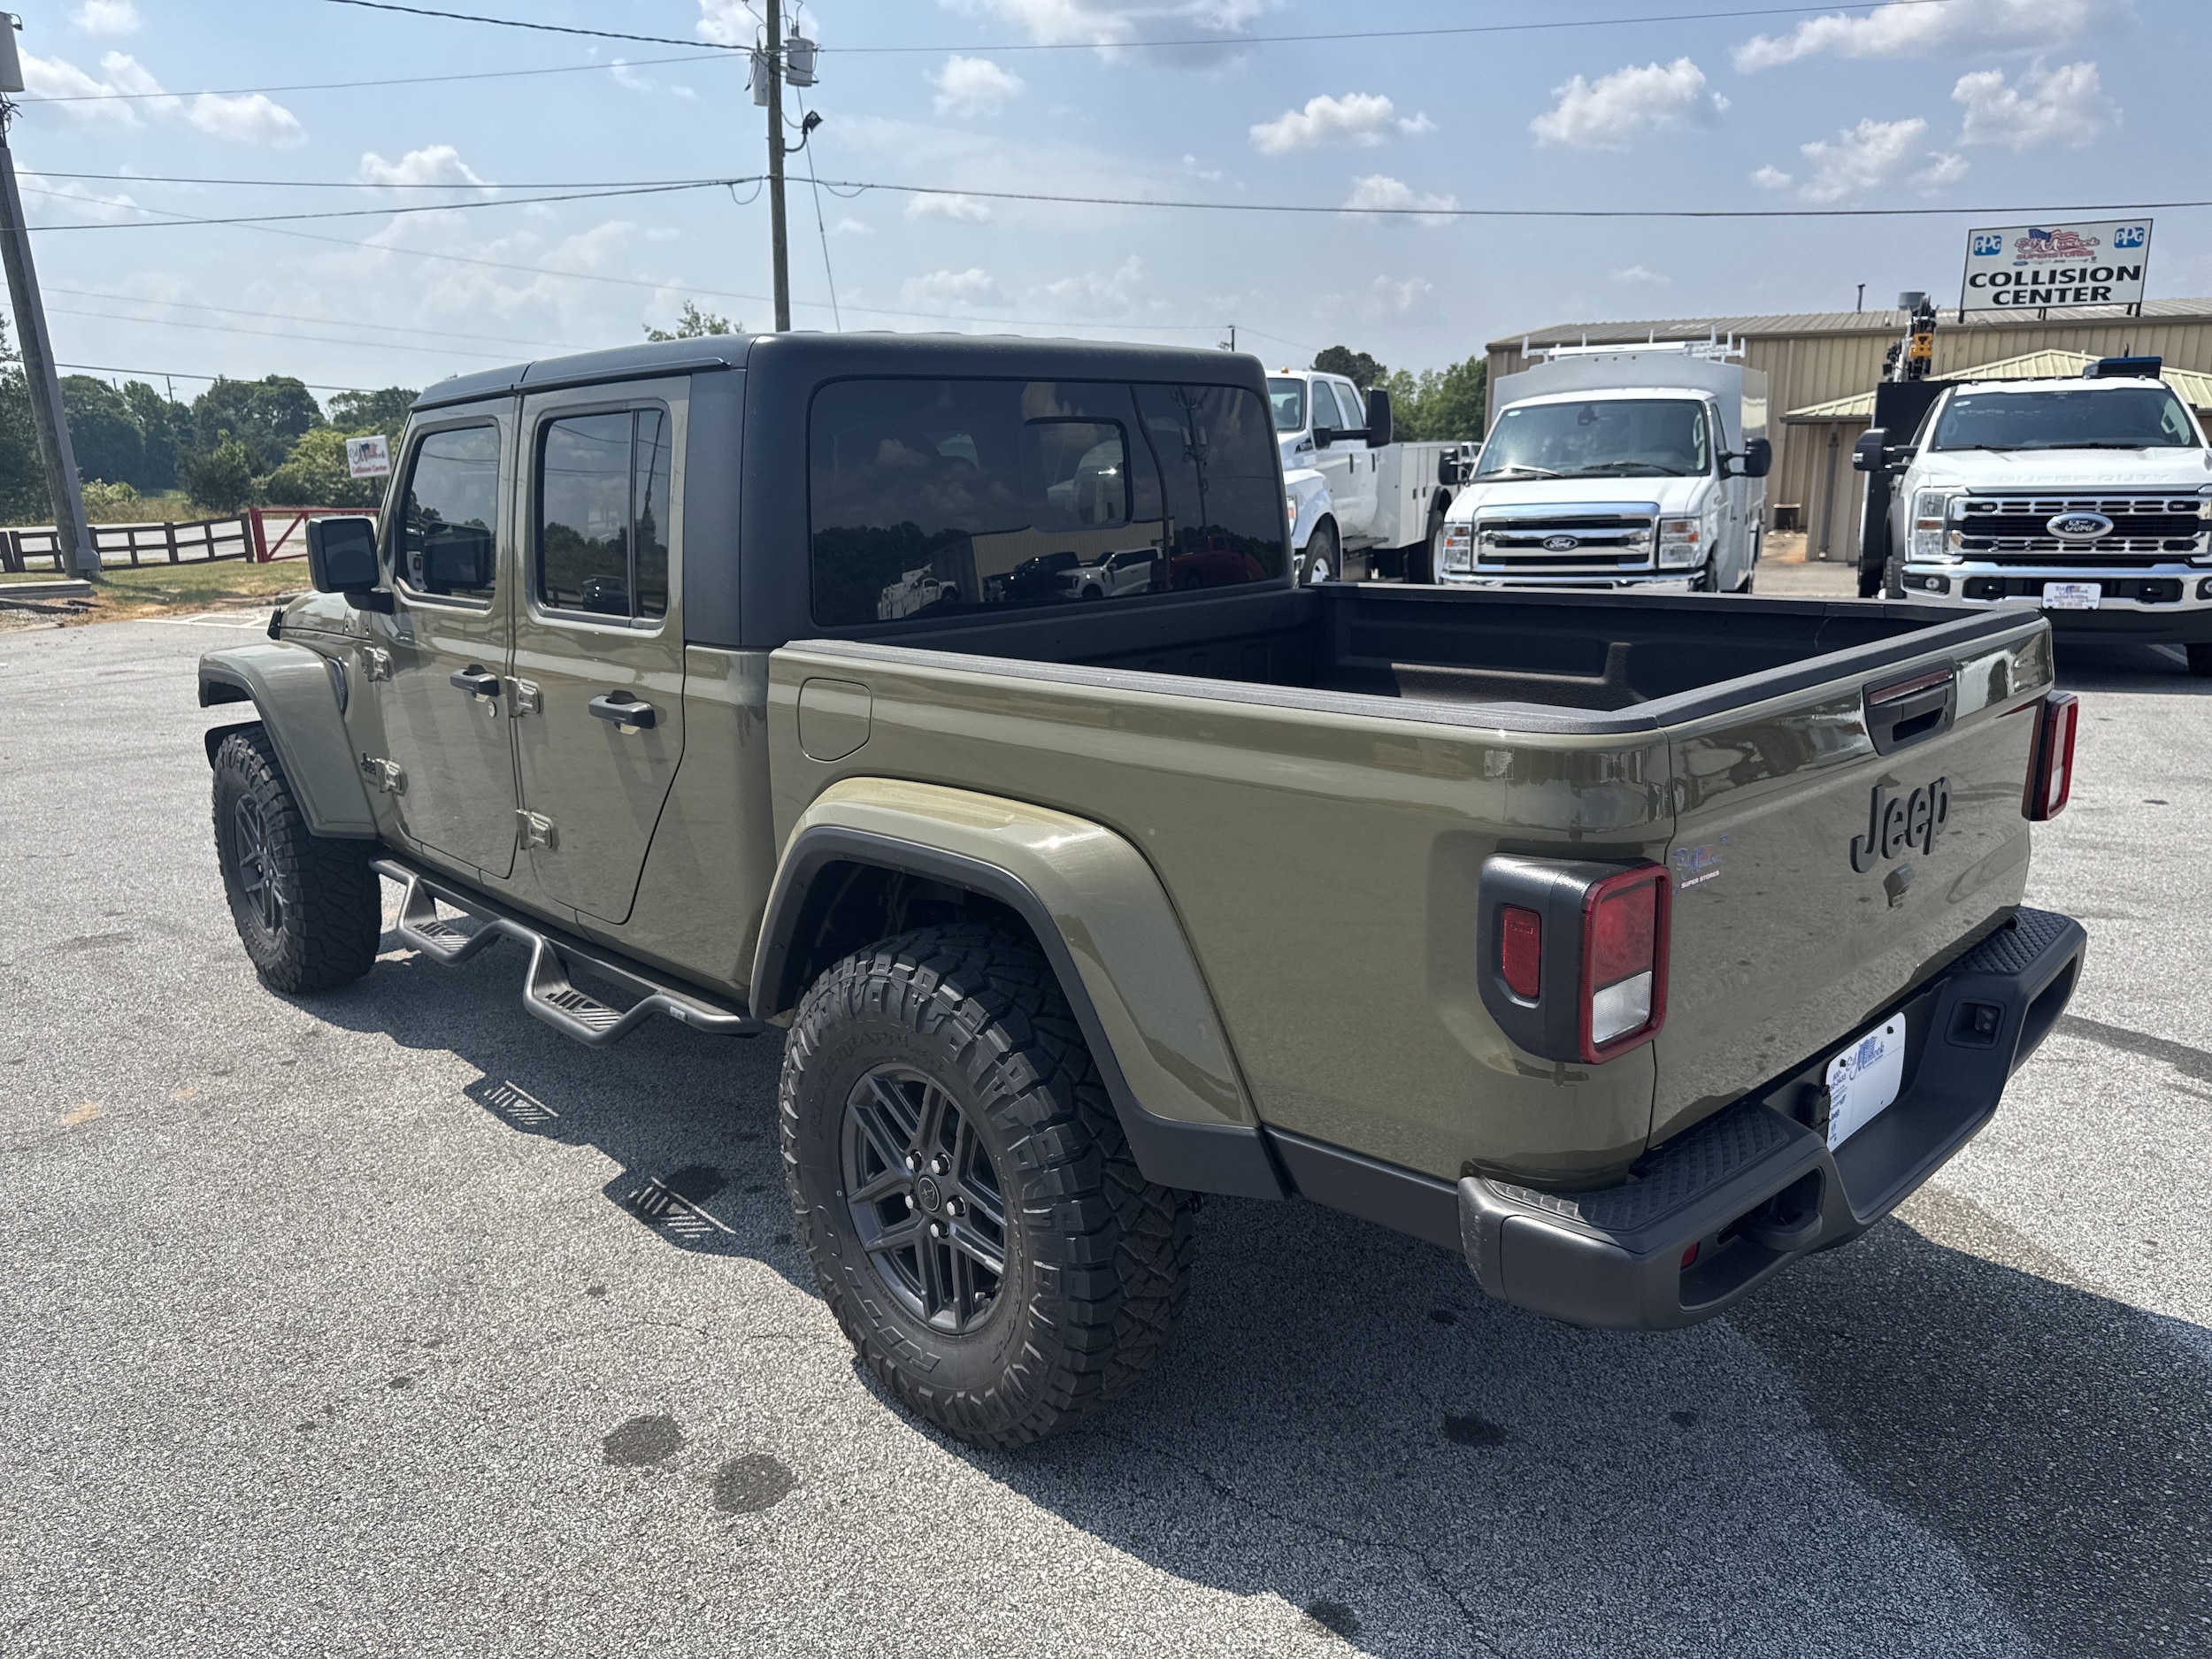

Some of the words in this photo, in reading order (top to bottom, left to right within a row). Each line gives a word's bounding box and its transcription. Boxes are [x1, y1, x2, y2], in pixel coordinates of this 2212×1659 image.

[1974, 235, 2001, 254] PPG
[2115, 227, 2145, 246] PPG
[1969, 265, 2141, 288] COLLISION
[1992, 286, 2112, 305] CENTER
[2064, 519, 2096, 532] Ford
[1548, 537, 1571, 549] Ford
[1849, 776, 1952, 873] Jeep
[1681, 878, 1699, 889] SUPER
